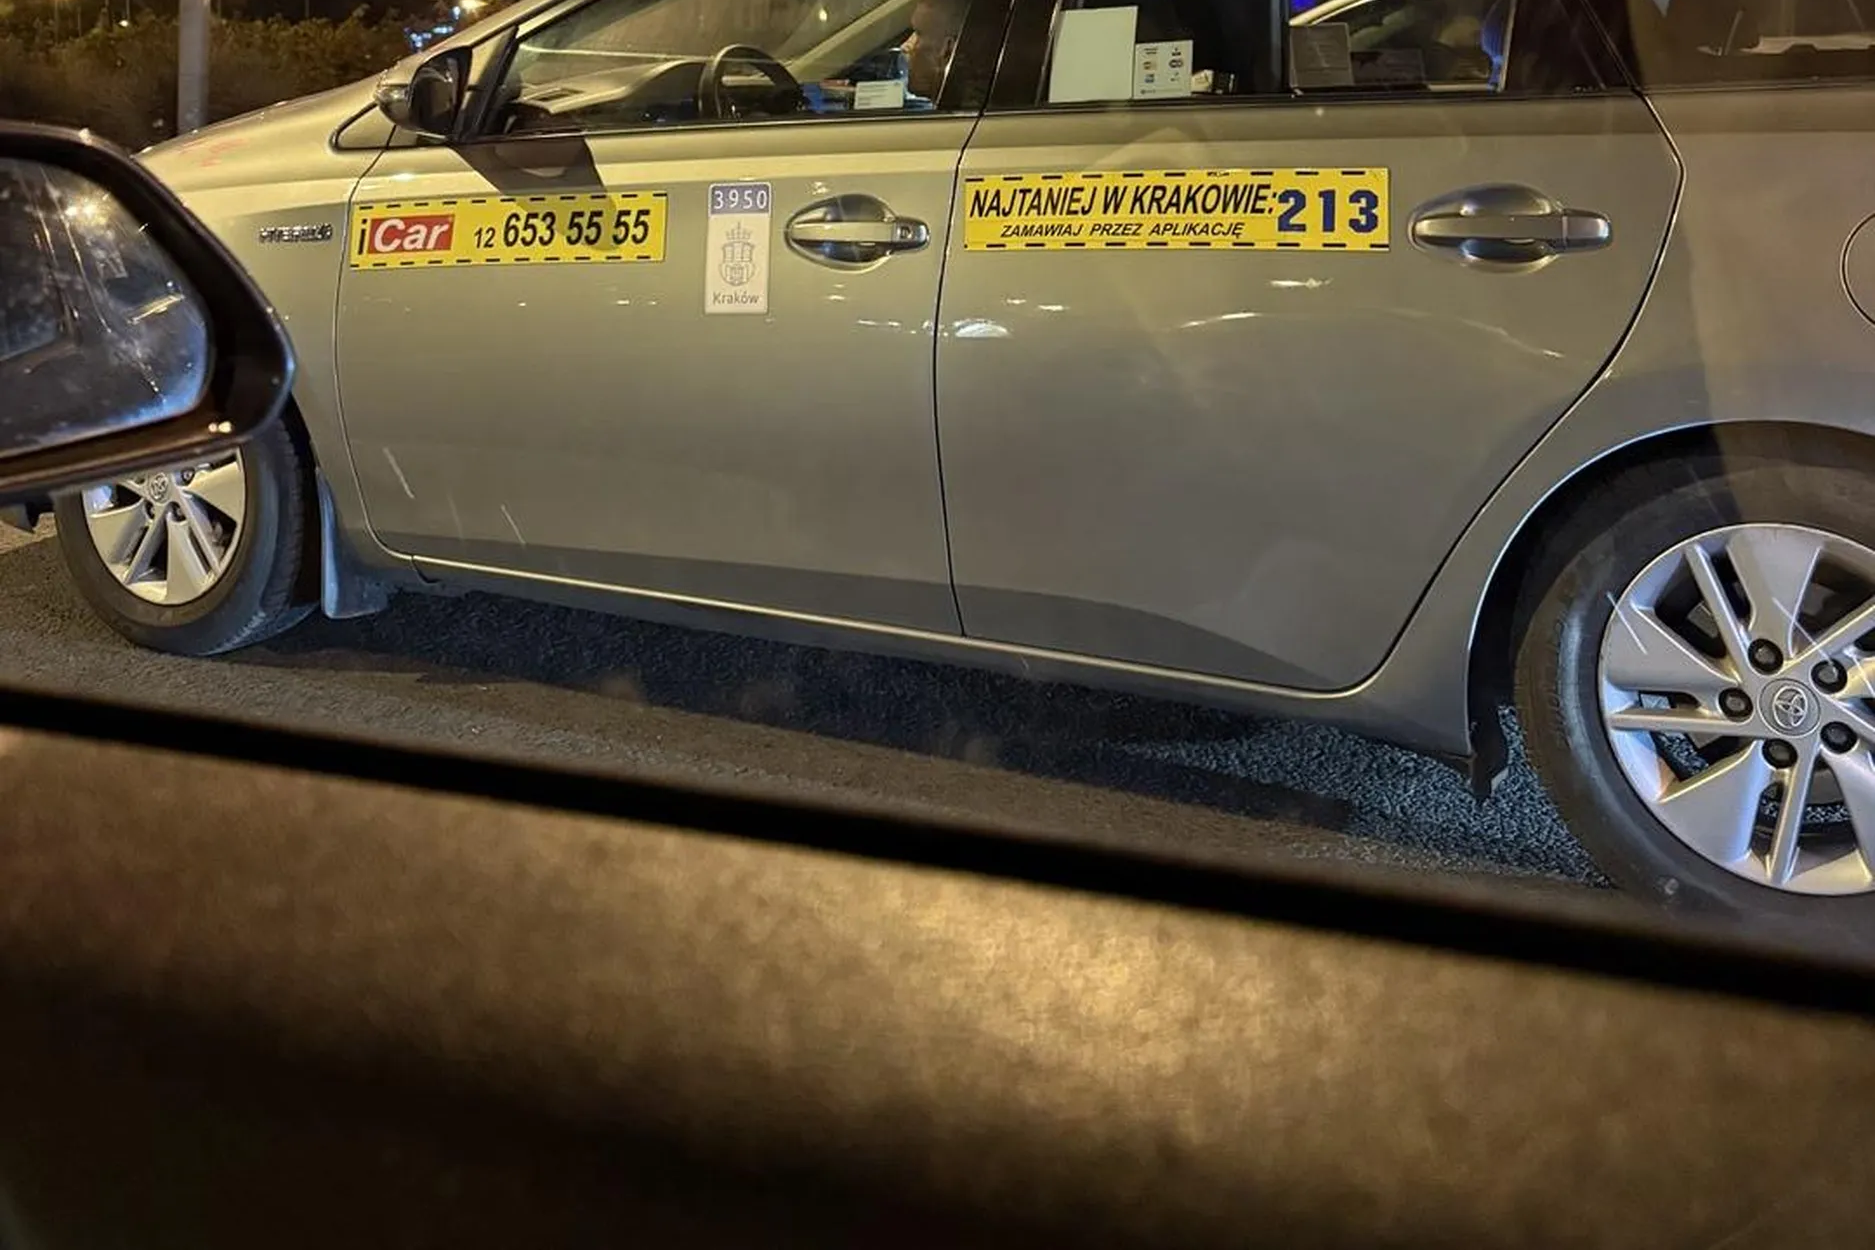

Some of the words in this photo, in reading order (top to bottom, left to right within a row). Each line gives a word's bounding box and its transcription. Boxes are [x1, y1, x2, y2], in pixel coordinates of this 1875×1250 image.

[713, 190, 767, 209] 3950
[969, 185, 1094, 218] NAJTANIEJ
[1101, 185, 1126, 214] W
[1276, 188, 1380, 233] 213
[474, 227, 496, 249] 12
[503, 212, 555, 248] 653
[566, 210, 603, 245] 55
[612, 209, 650, 244] 55
[1000, 223, 1083, 239] ZAMAWIAJ
[1089, 222, 1144, 237] PRZEZ
[1149, 221, 1246, 240] APLIKACJĘ
[712, 291, 760, 305] Kraków
